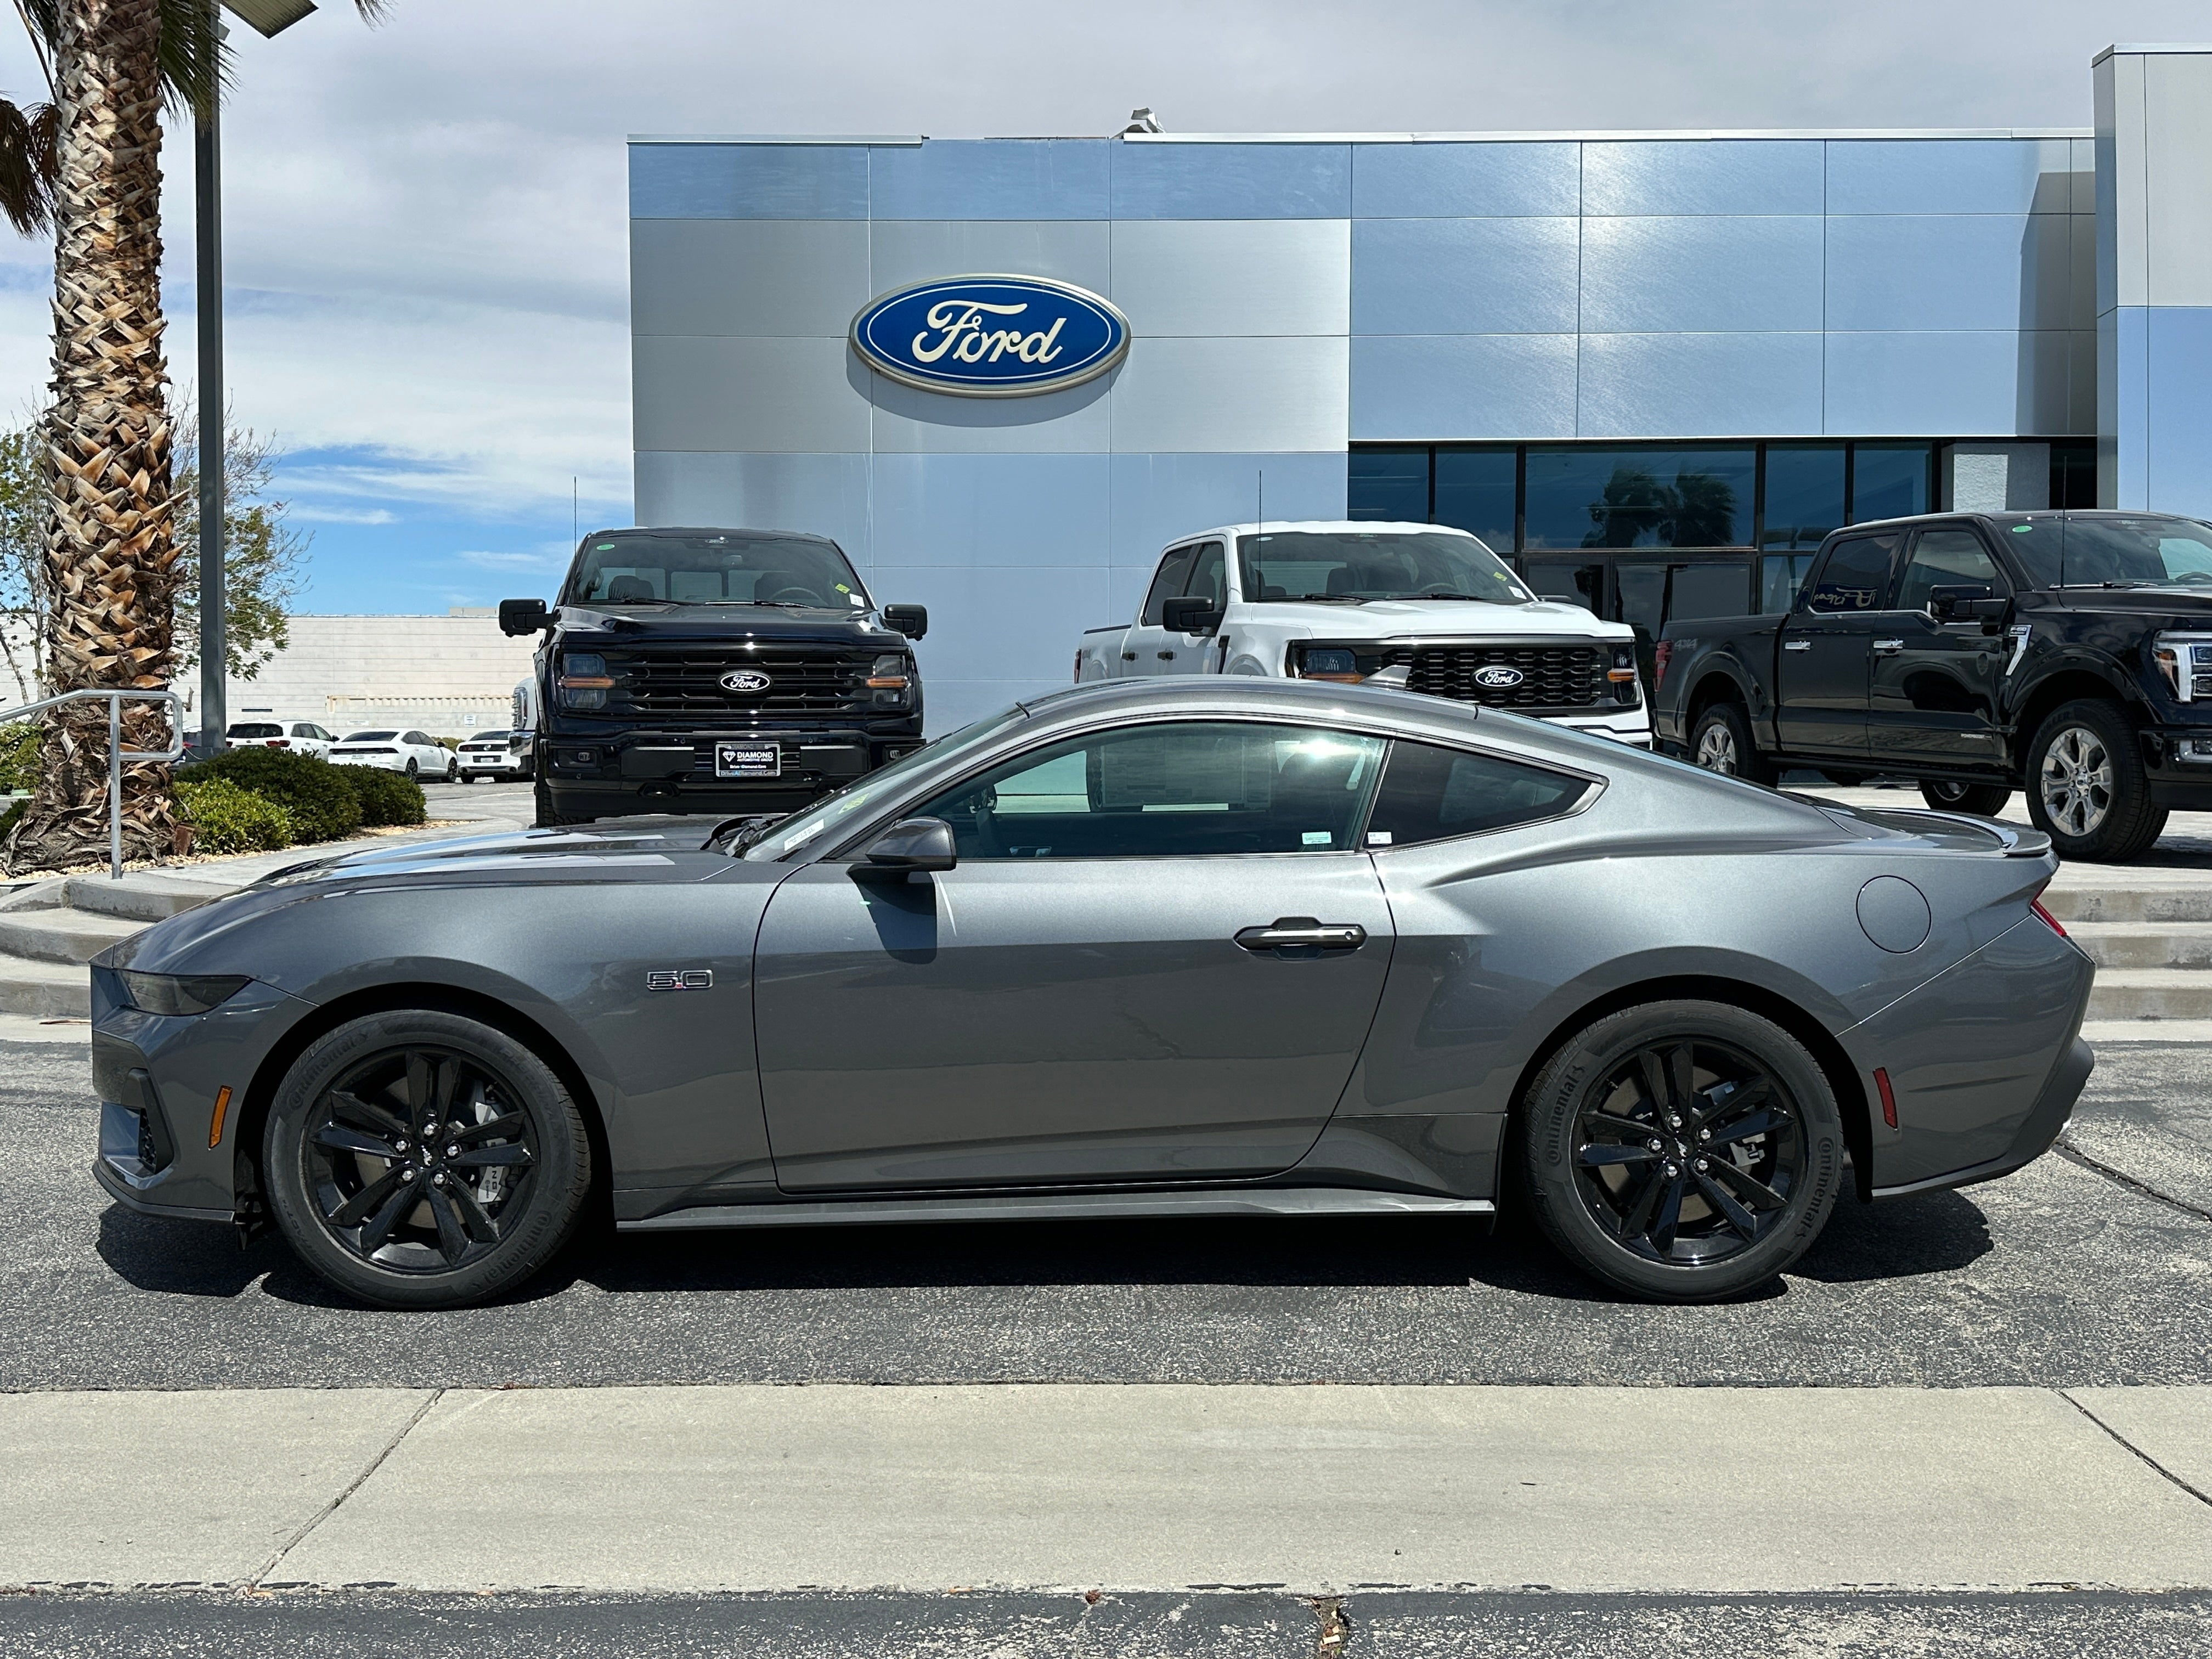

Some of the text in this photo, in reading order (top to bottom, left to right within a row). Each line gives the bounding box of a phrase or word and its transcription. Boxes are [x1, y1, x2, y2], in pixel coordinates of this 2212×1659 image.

[912, 300, 1067, 363] Ford
[730, 675, 761, 689] Ford
[1485, 670, 1515, 684] Ford
[647, 969, 713, 990] 5.0
[287, 1036, 357, 1110] Continental
[1545, 1074, 1580, 1167] Continental
[1800, 1137, 1835, 1229] Continental
[482, 1210, 553, 1284] Continental
